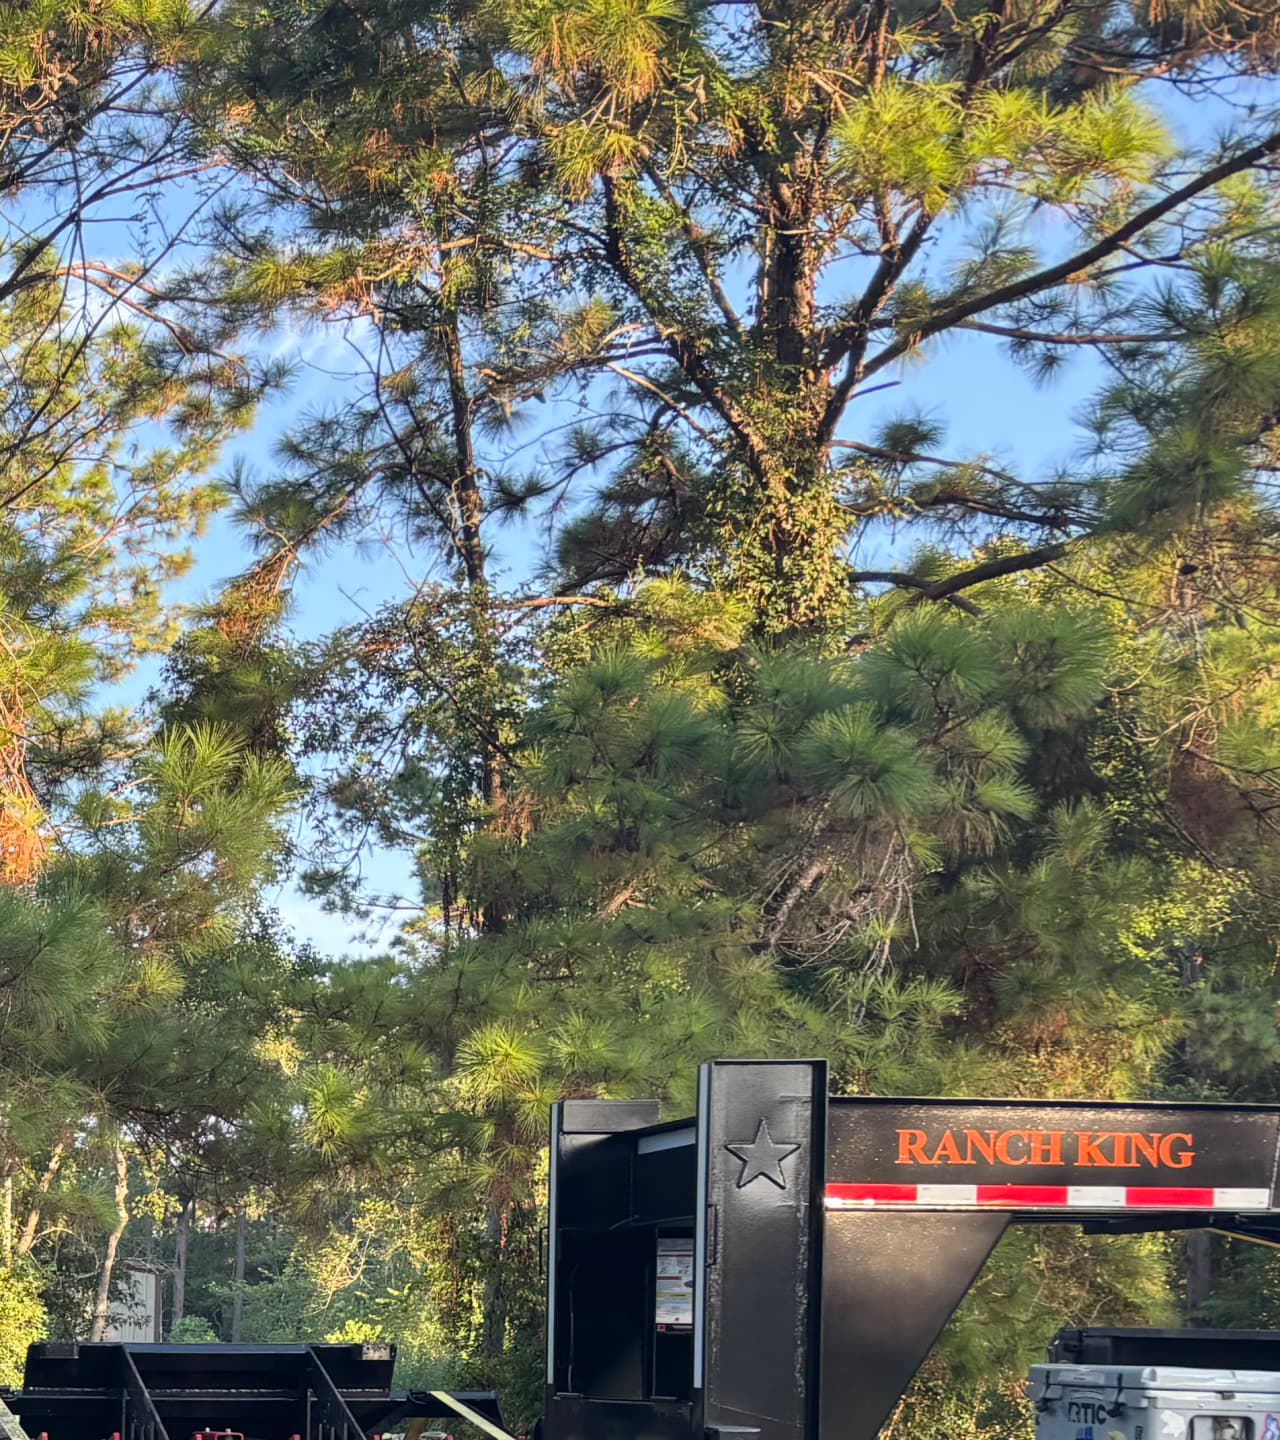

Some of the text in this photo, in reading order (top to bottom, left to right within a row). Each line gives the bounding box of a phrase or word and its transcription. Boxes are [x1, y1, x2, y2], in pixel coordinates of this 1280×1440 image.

[894, 1128, 1196, 1169] RANCH KING
[1068, 1402, 1107, 1425] RTIC
